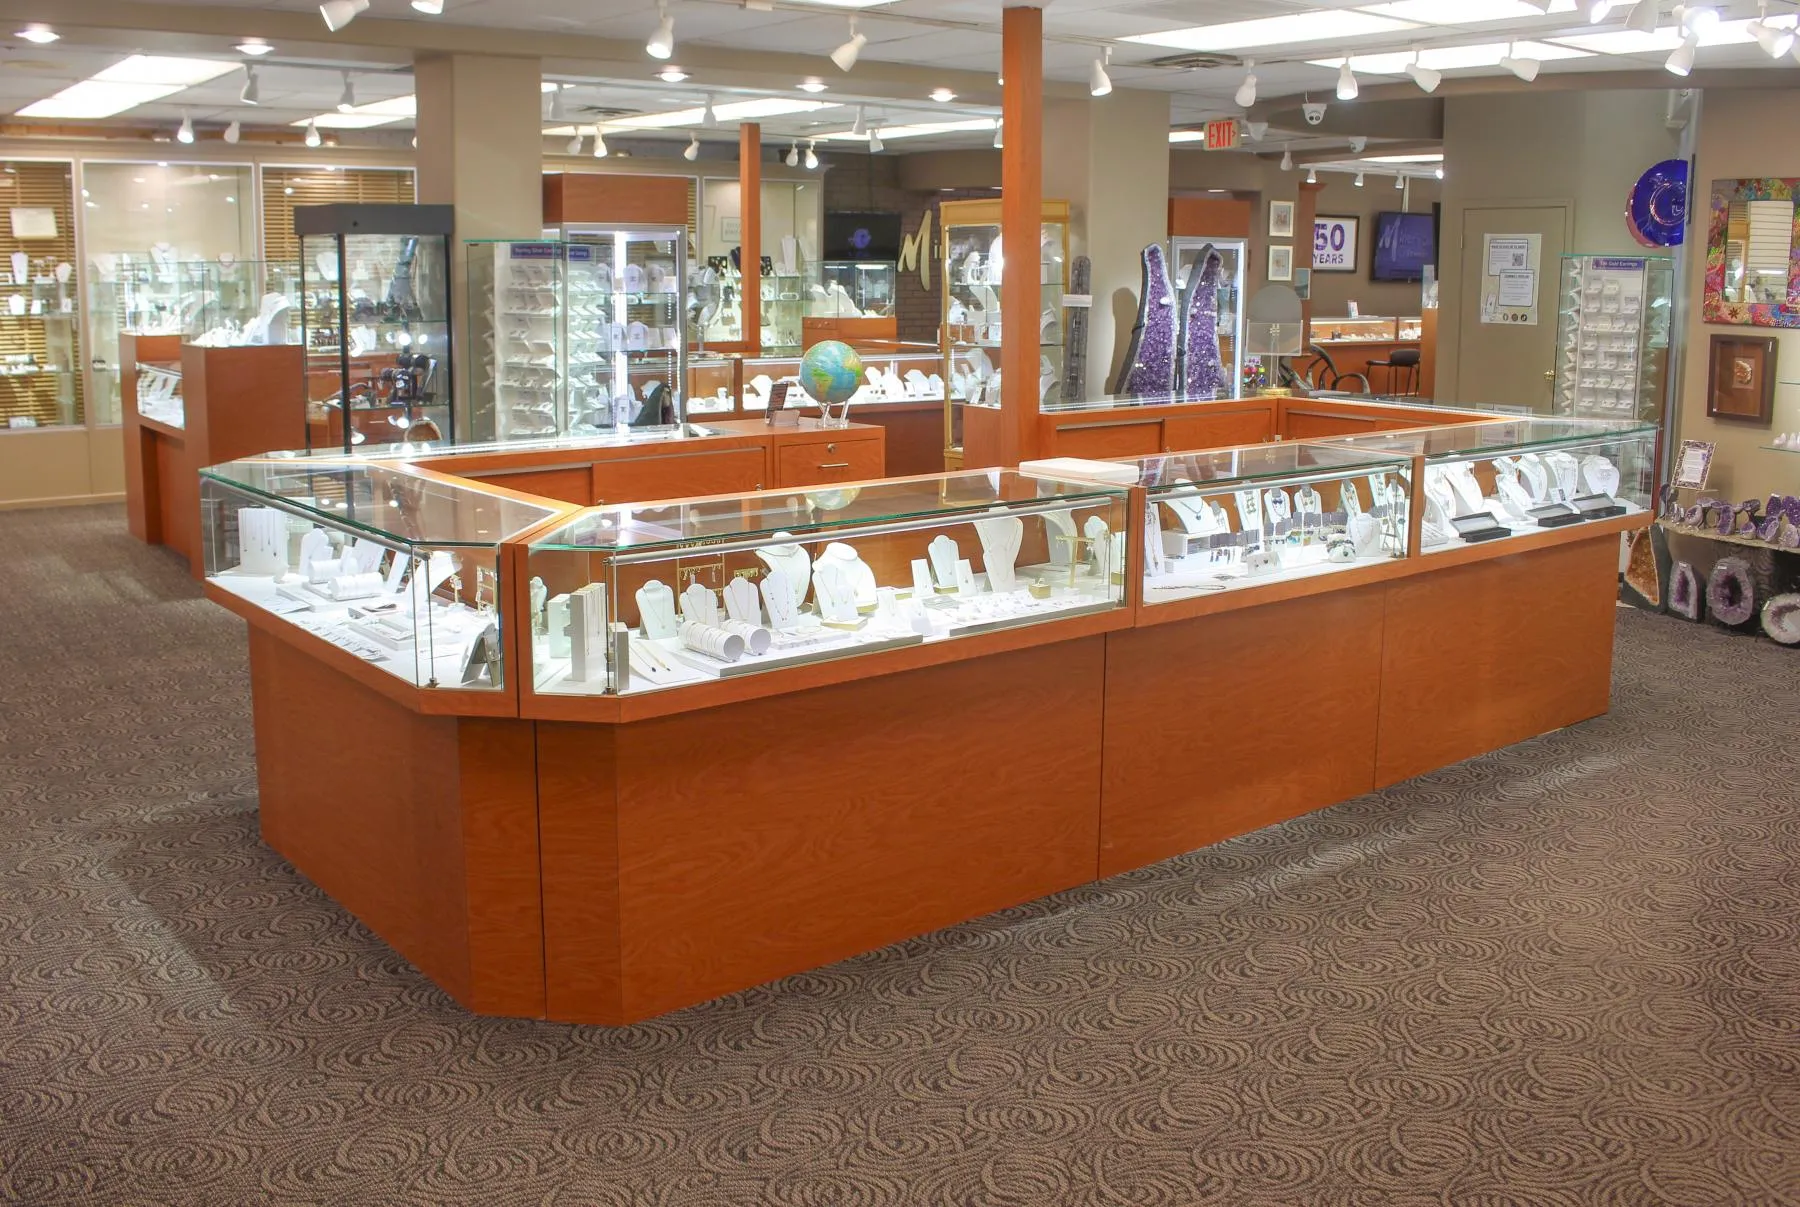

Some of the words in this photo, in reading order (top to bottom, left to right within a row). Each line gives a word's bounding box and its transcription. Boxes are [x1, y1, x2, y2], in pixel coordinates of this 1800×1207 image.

[1208, 121, 1233, 148] EXIT
[1314, 223, 1345, 251] 50
[1313, 253, 1344, 264] YEARS
